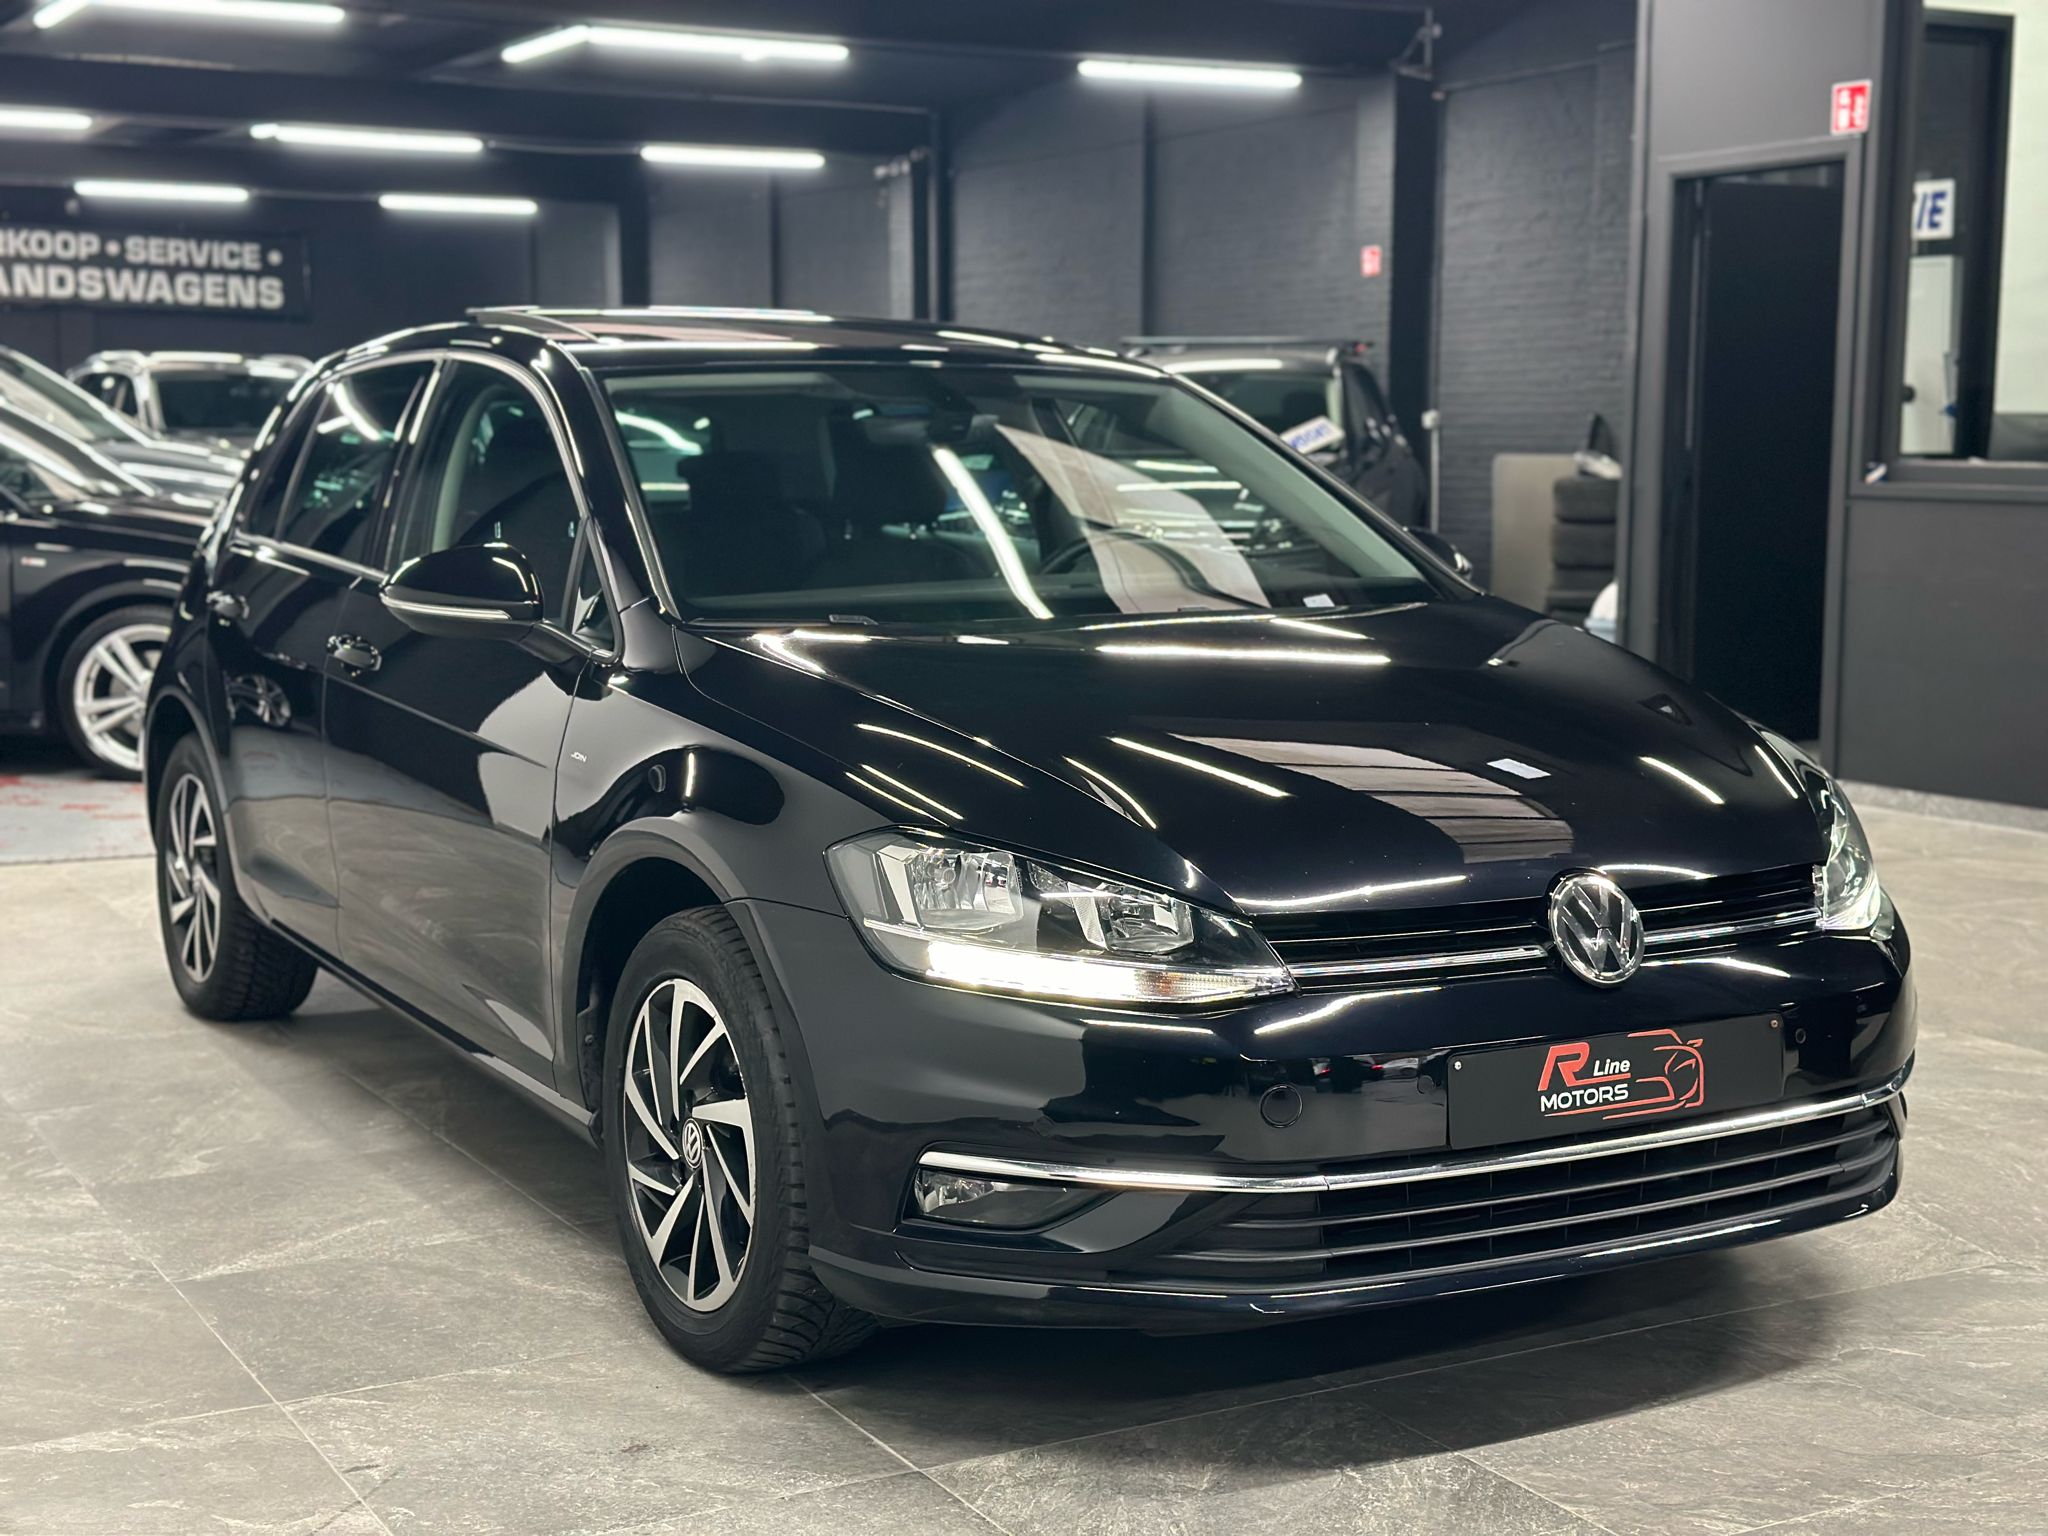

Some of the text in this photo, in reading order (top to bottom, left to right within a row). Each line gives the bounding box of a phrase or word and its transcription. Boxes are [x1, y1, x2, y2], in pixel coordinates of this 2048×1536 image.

[0, 229, 262, 270] KOOP SERVICE
[1538, 1042, 1630, 1091] R Line
[1541, 1083, 1629, 1112] MOTORS
